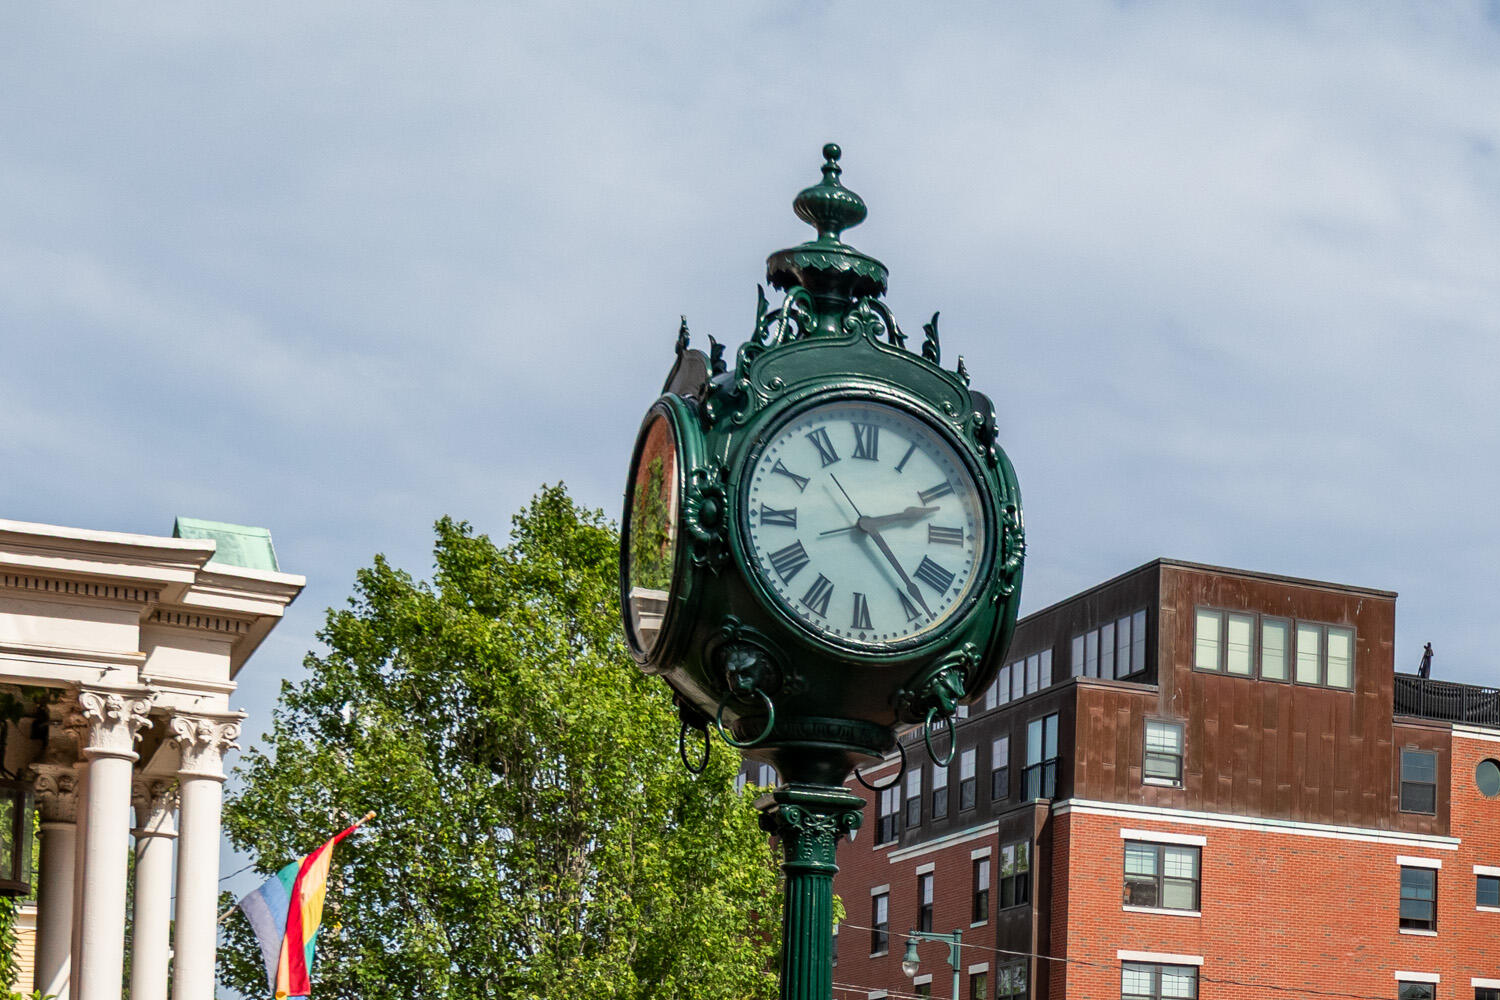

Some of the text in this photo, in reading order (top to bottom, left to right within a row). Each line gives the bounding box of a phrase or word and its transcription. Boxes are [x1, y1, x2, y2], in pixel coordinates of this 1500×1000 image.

[805, 426, 841, 468] XI
[851, 422, 880, 461] XII
[894, 440, 918, 474] I
[770, 458, 811, 493] X
[917, 479, 955, 506] II
[760, 502, 797, 529] IX
[928, 523, 964, 548] III
[767, 539, 810, 587] VIII
[799, 572, 834, 619] VII
[850, 592, 874, 630] VI
[897, 587, 922, 622] V
